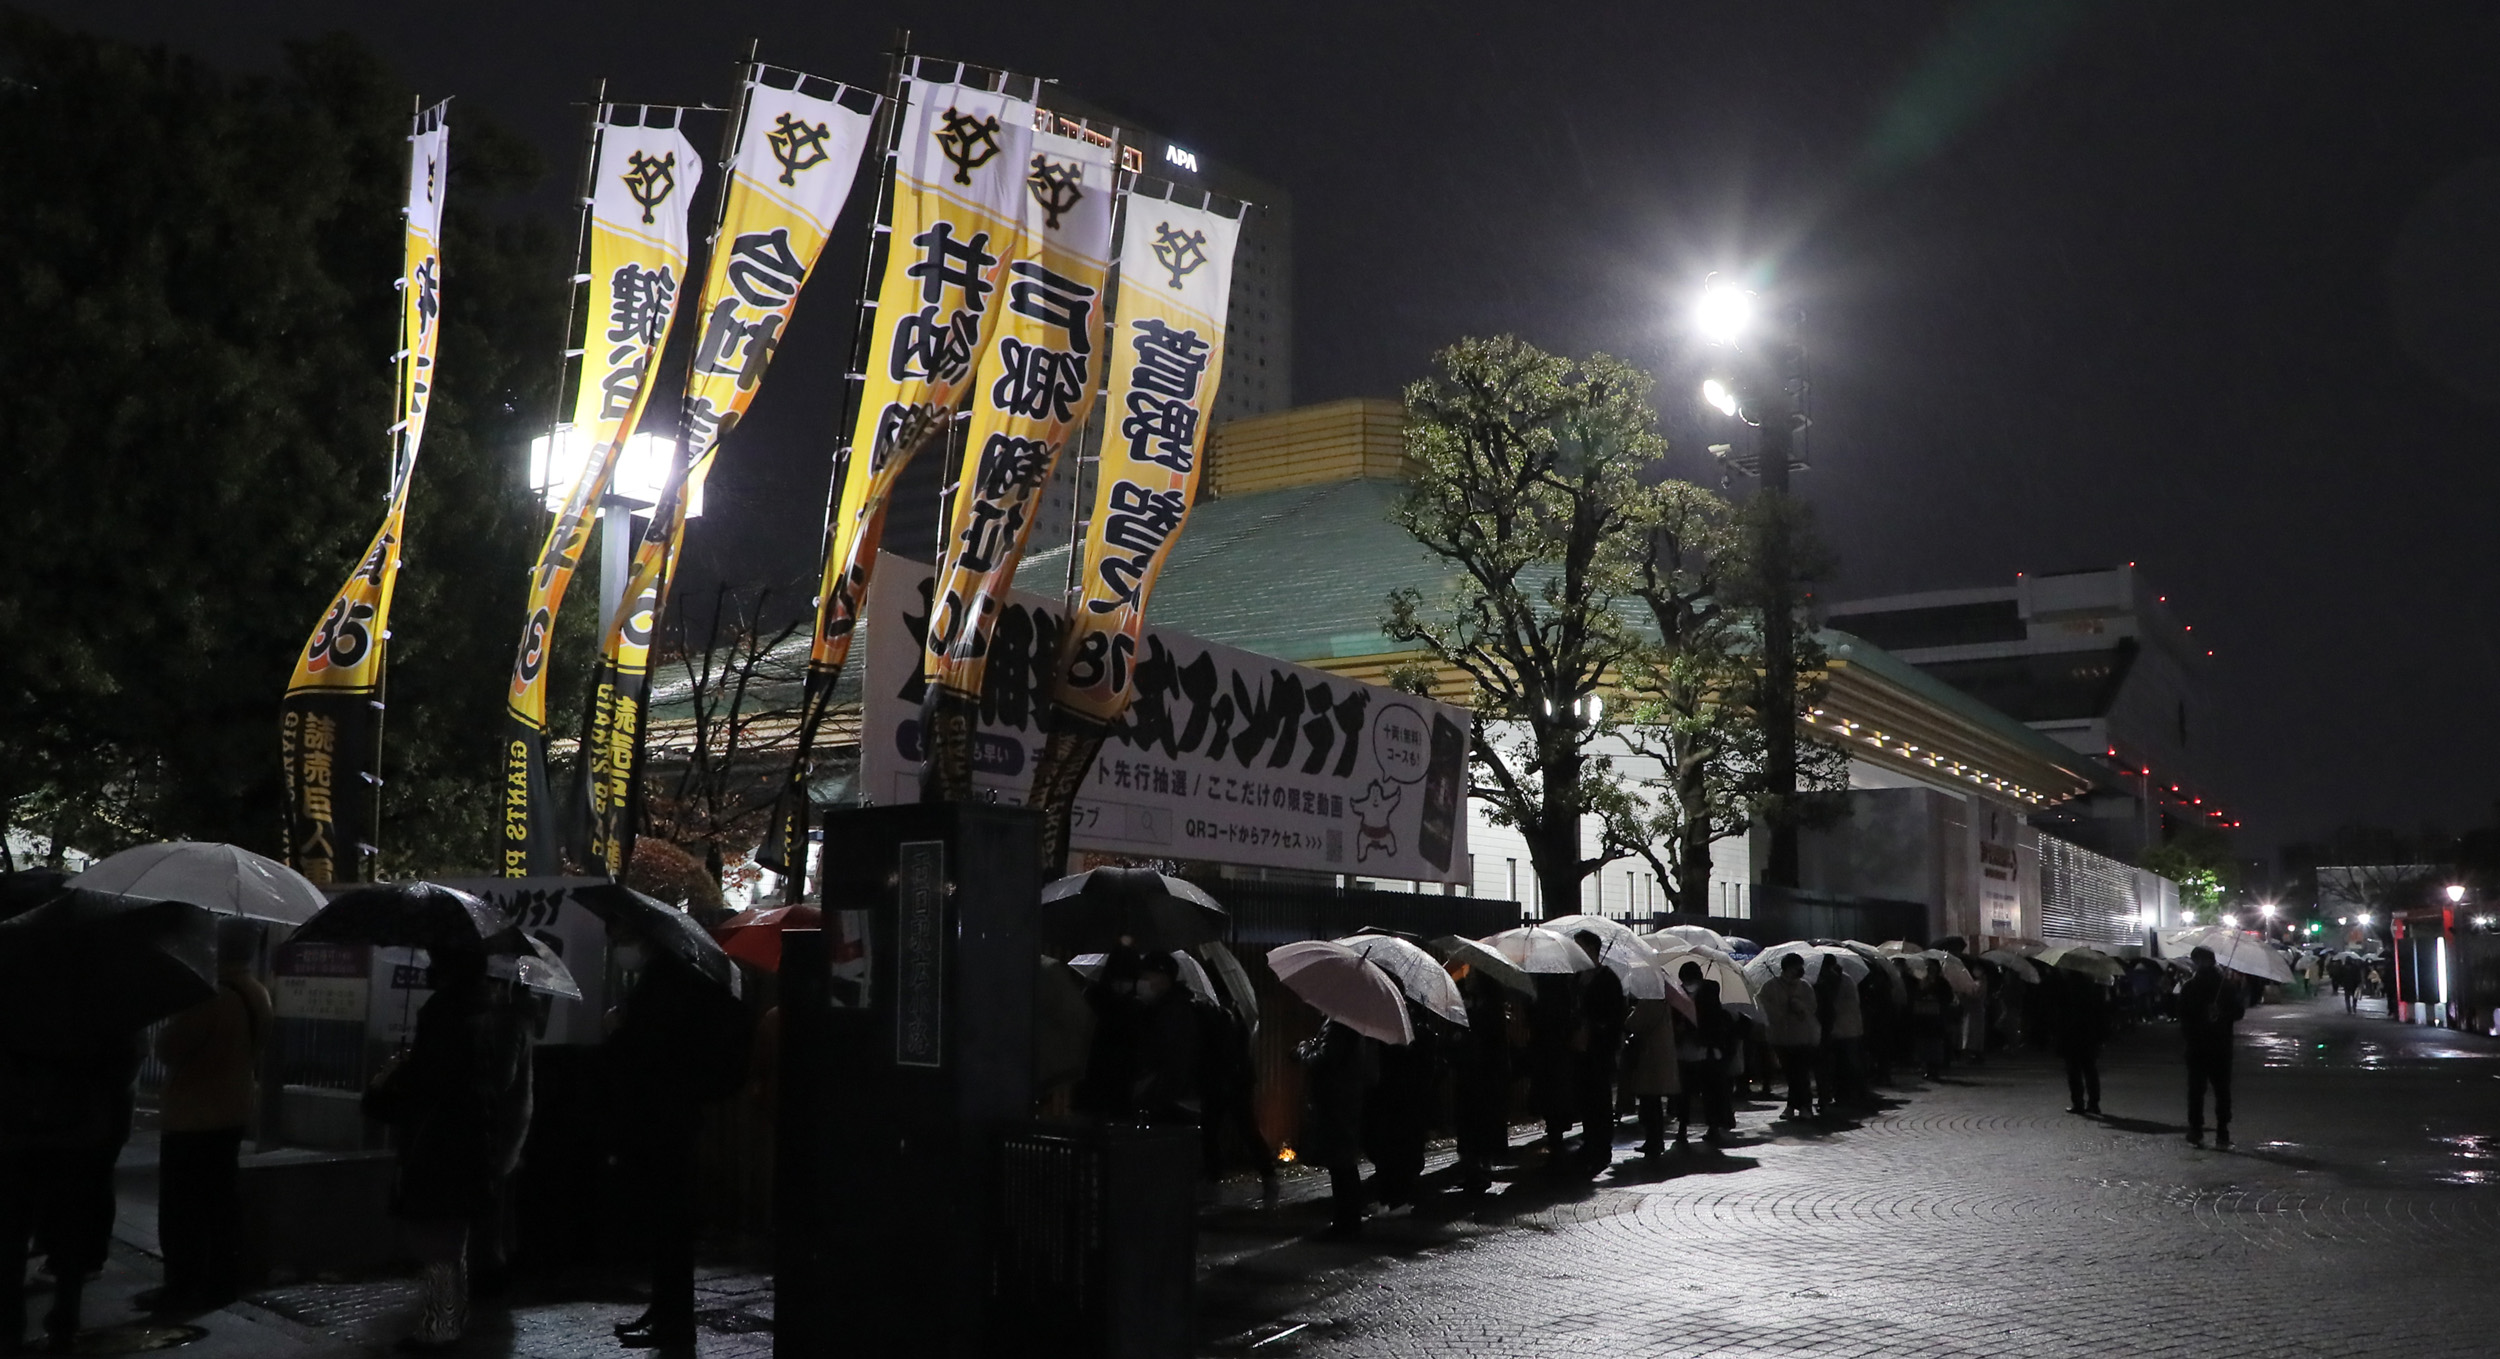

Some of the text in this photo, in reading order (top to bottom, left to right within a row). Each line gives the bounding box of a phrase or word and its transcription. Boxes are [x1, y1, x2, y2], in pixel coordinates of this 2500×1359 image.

[1166, 144, 1198, 173] APA
[308, 597, 374, 668] 35
[1208, 775, 1344, 819] ここだけの限定動画
[1186, 818, 1302, 850] QRコードからアクセス
